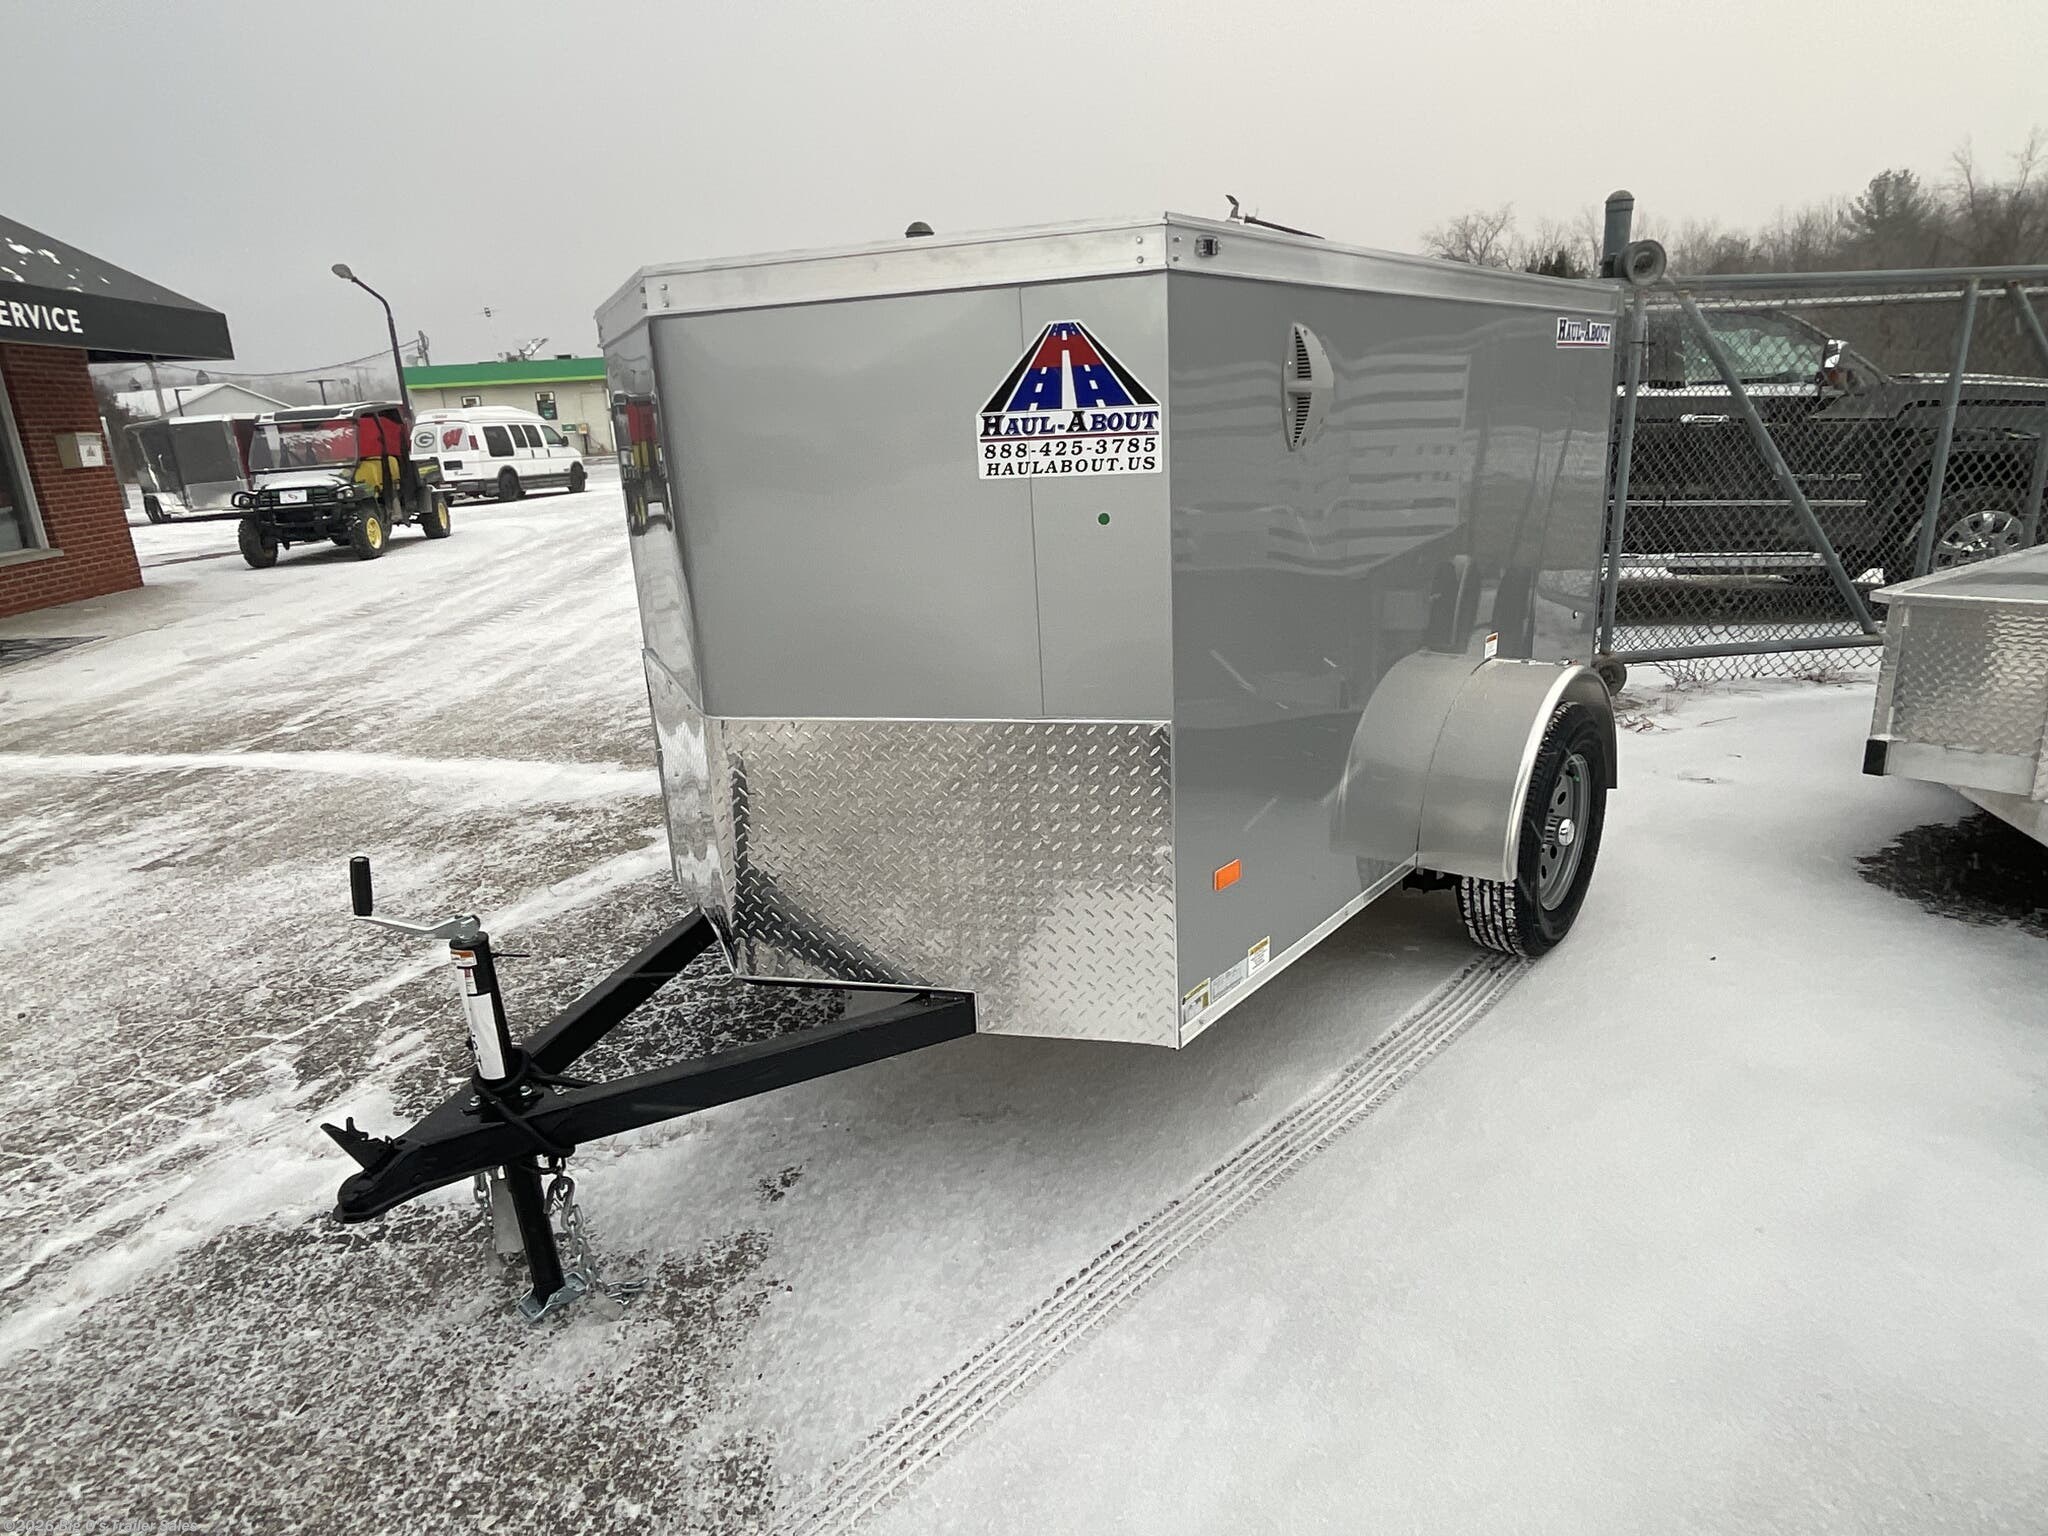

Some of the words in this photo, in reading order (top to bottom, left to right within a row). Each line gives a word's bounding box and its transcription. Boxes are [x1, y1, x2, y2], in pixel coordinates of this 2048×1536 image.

[980, 411, 1159, 437] HAUL-ABOUT
[984, 437, 1156, 459] 888-425-3785
[986, 456, 1156, 476] HAULABOUT.US
